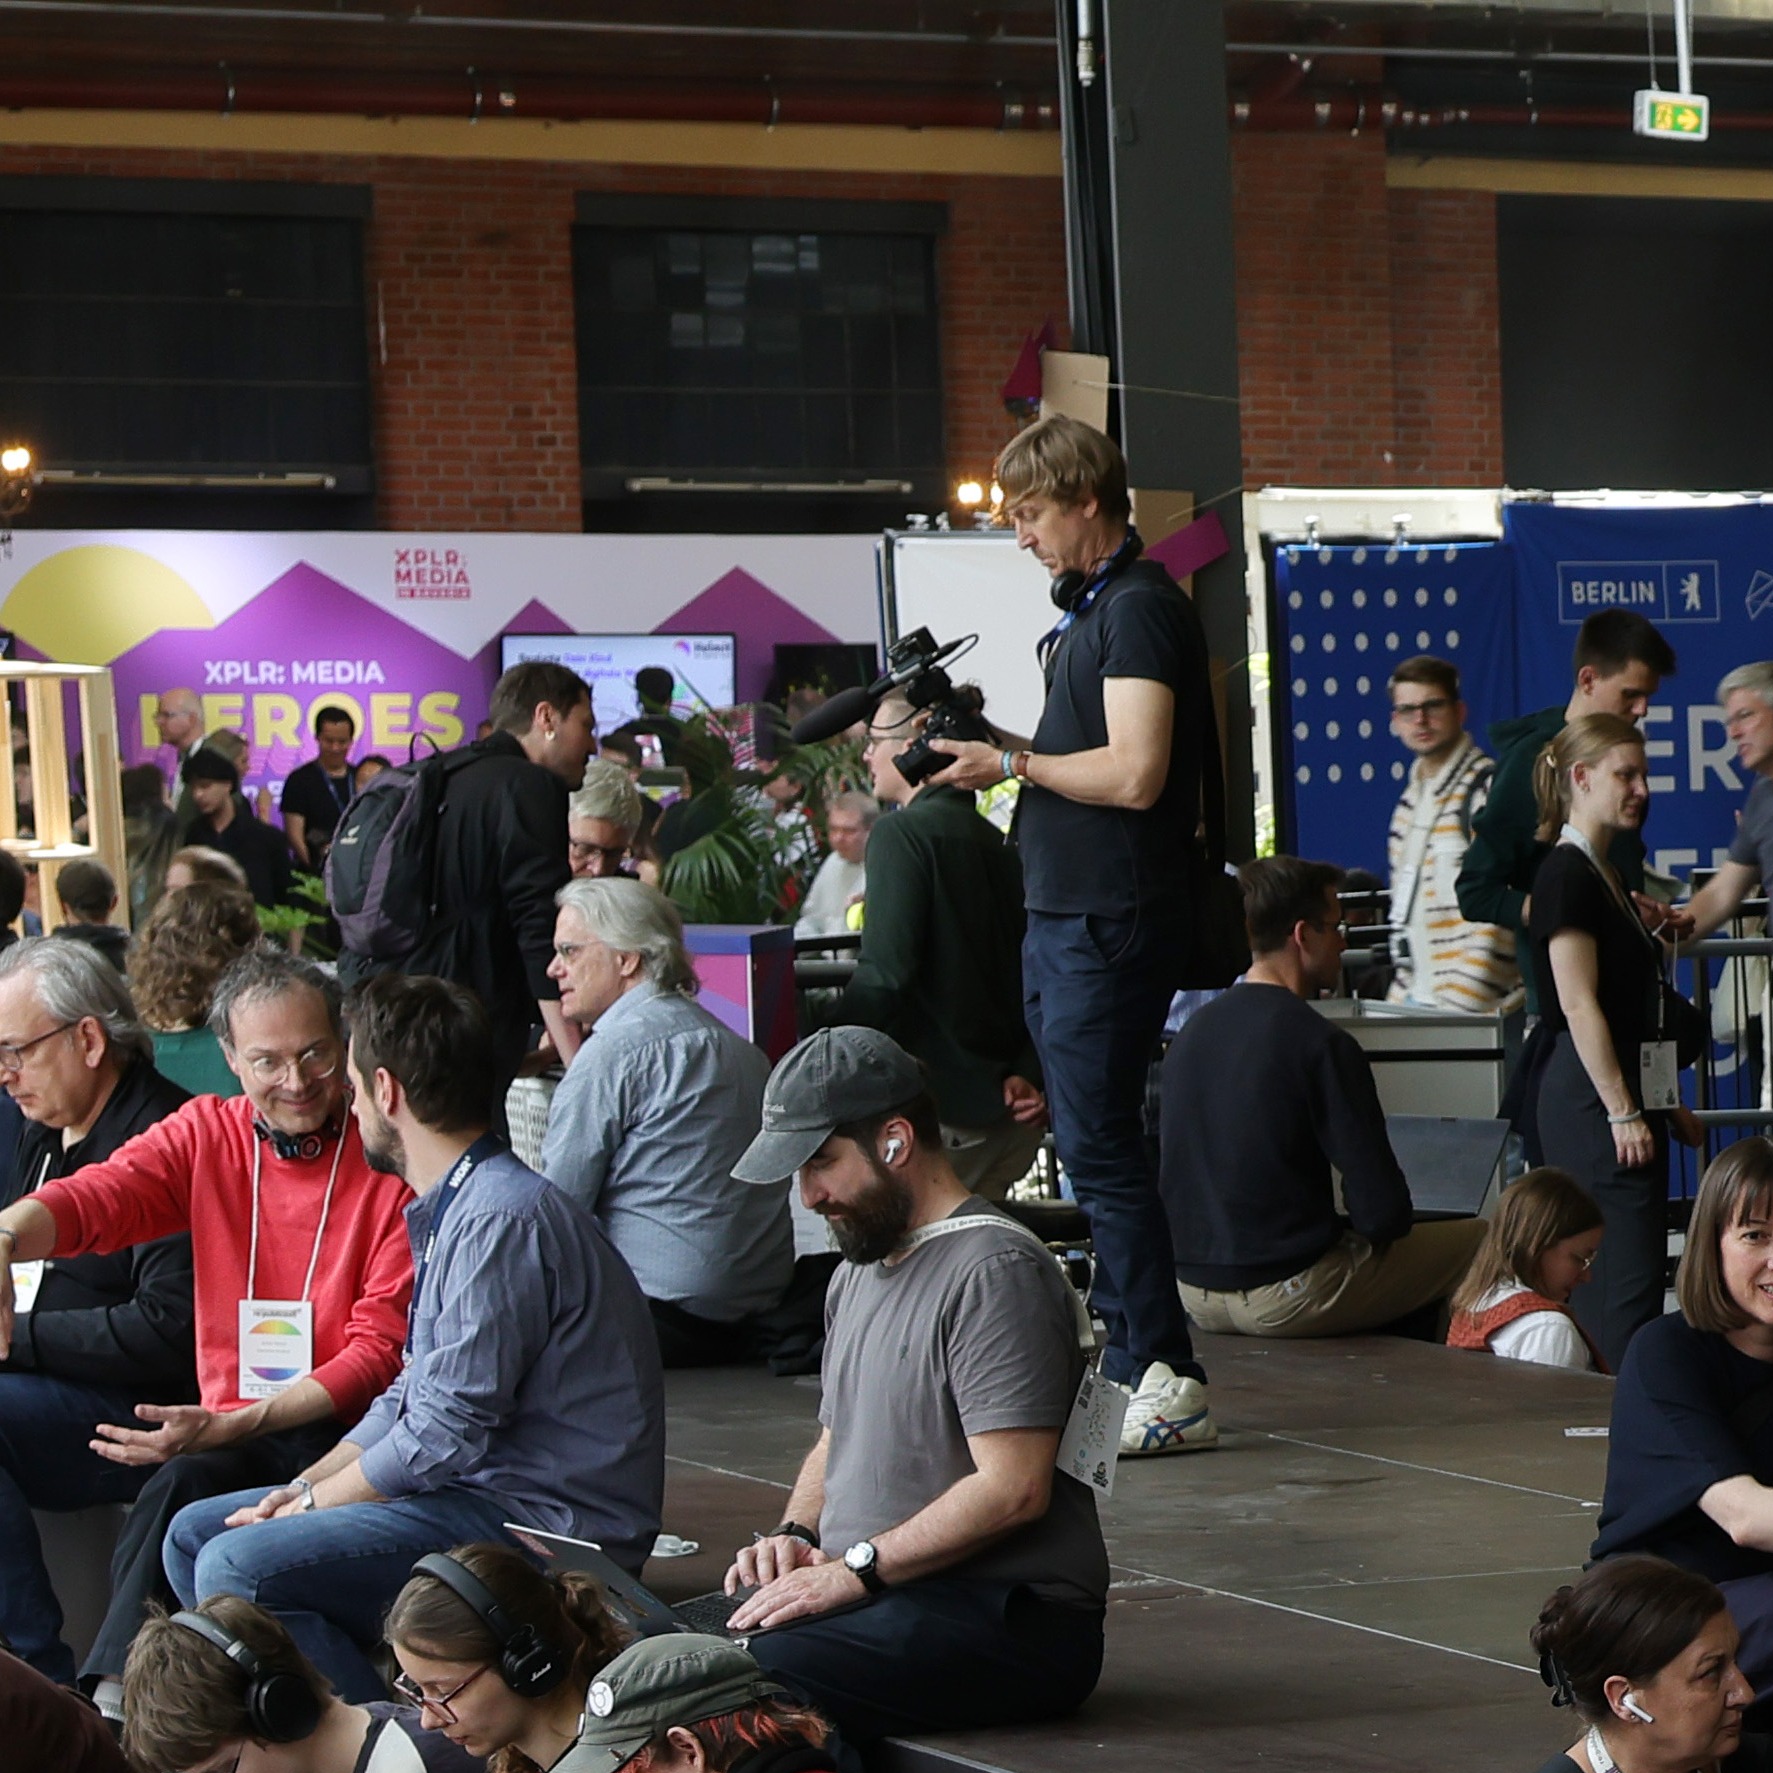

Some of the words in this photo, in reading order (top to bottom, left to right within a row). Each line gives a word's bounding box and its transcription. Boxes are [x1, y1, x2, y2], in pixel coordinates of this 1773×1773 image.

[395, 570, 469, 585] MEDIA
[1571, 580, 1656, 605] BERLIN
[204, 660, 286, 685] XPLR:
[292, 660, 385, 685] MEDIA
